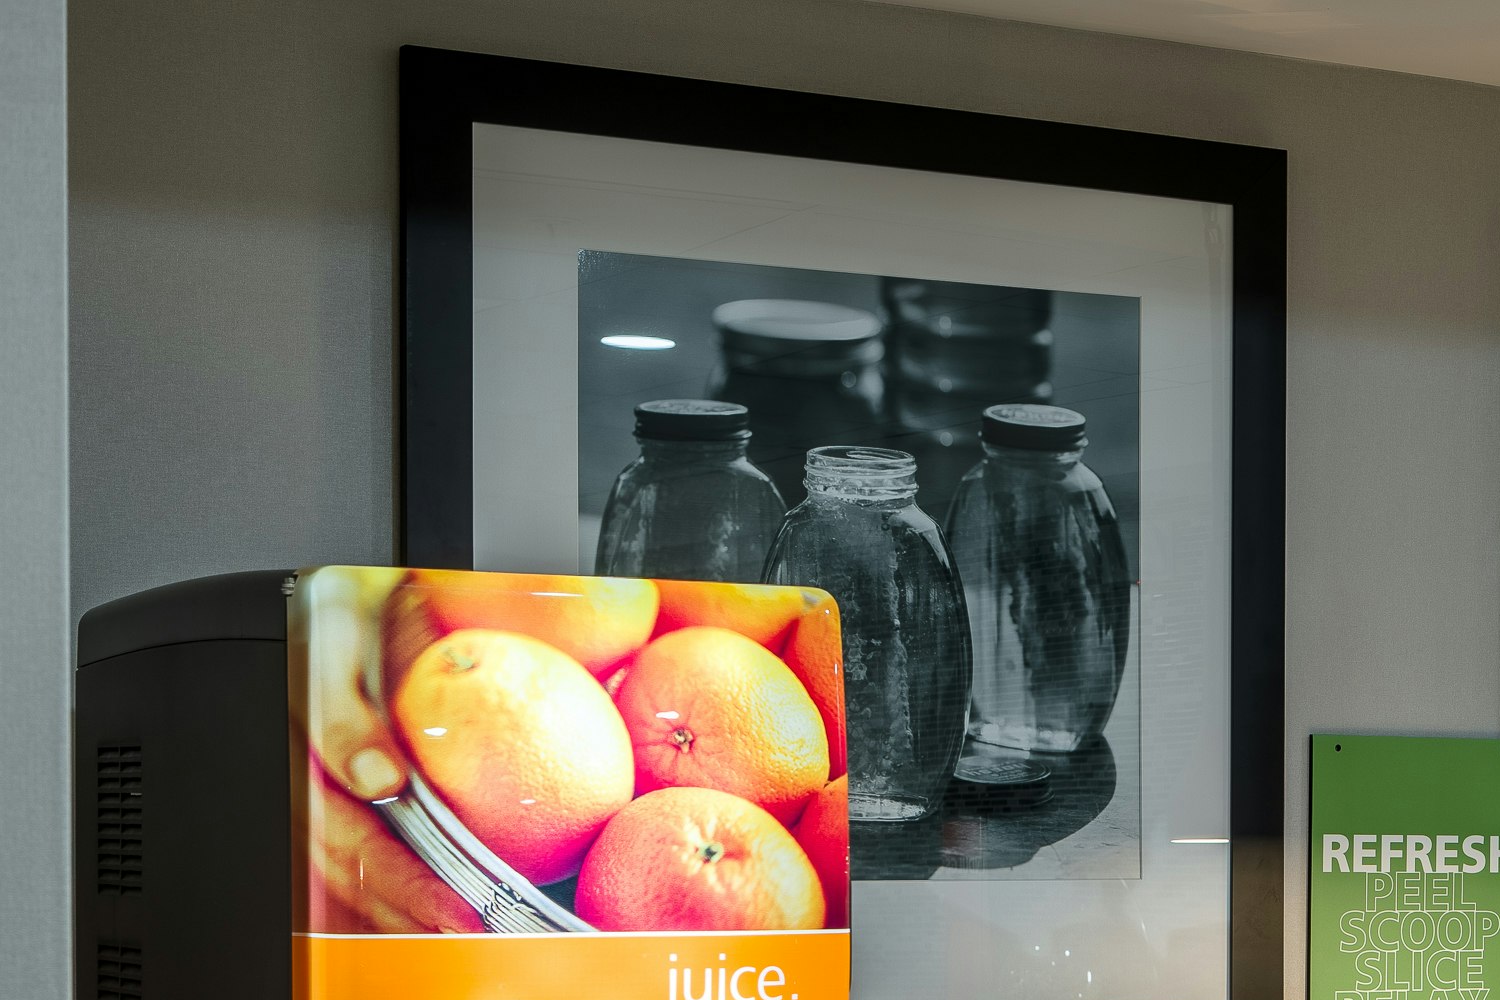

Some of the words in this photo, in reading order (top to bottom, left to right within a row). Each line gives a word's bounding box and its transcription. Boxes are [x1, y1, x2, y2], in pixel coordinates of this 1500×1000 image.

[1365, 872, 1477, 912] PEEL
[1339, 910, 1500, 952] SCOOP
[1355, 950, 1484, 992] SLICE
